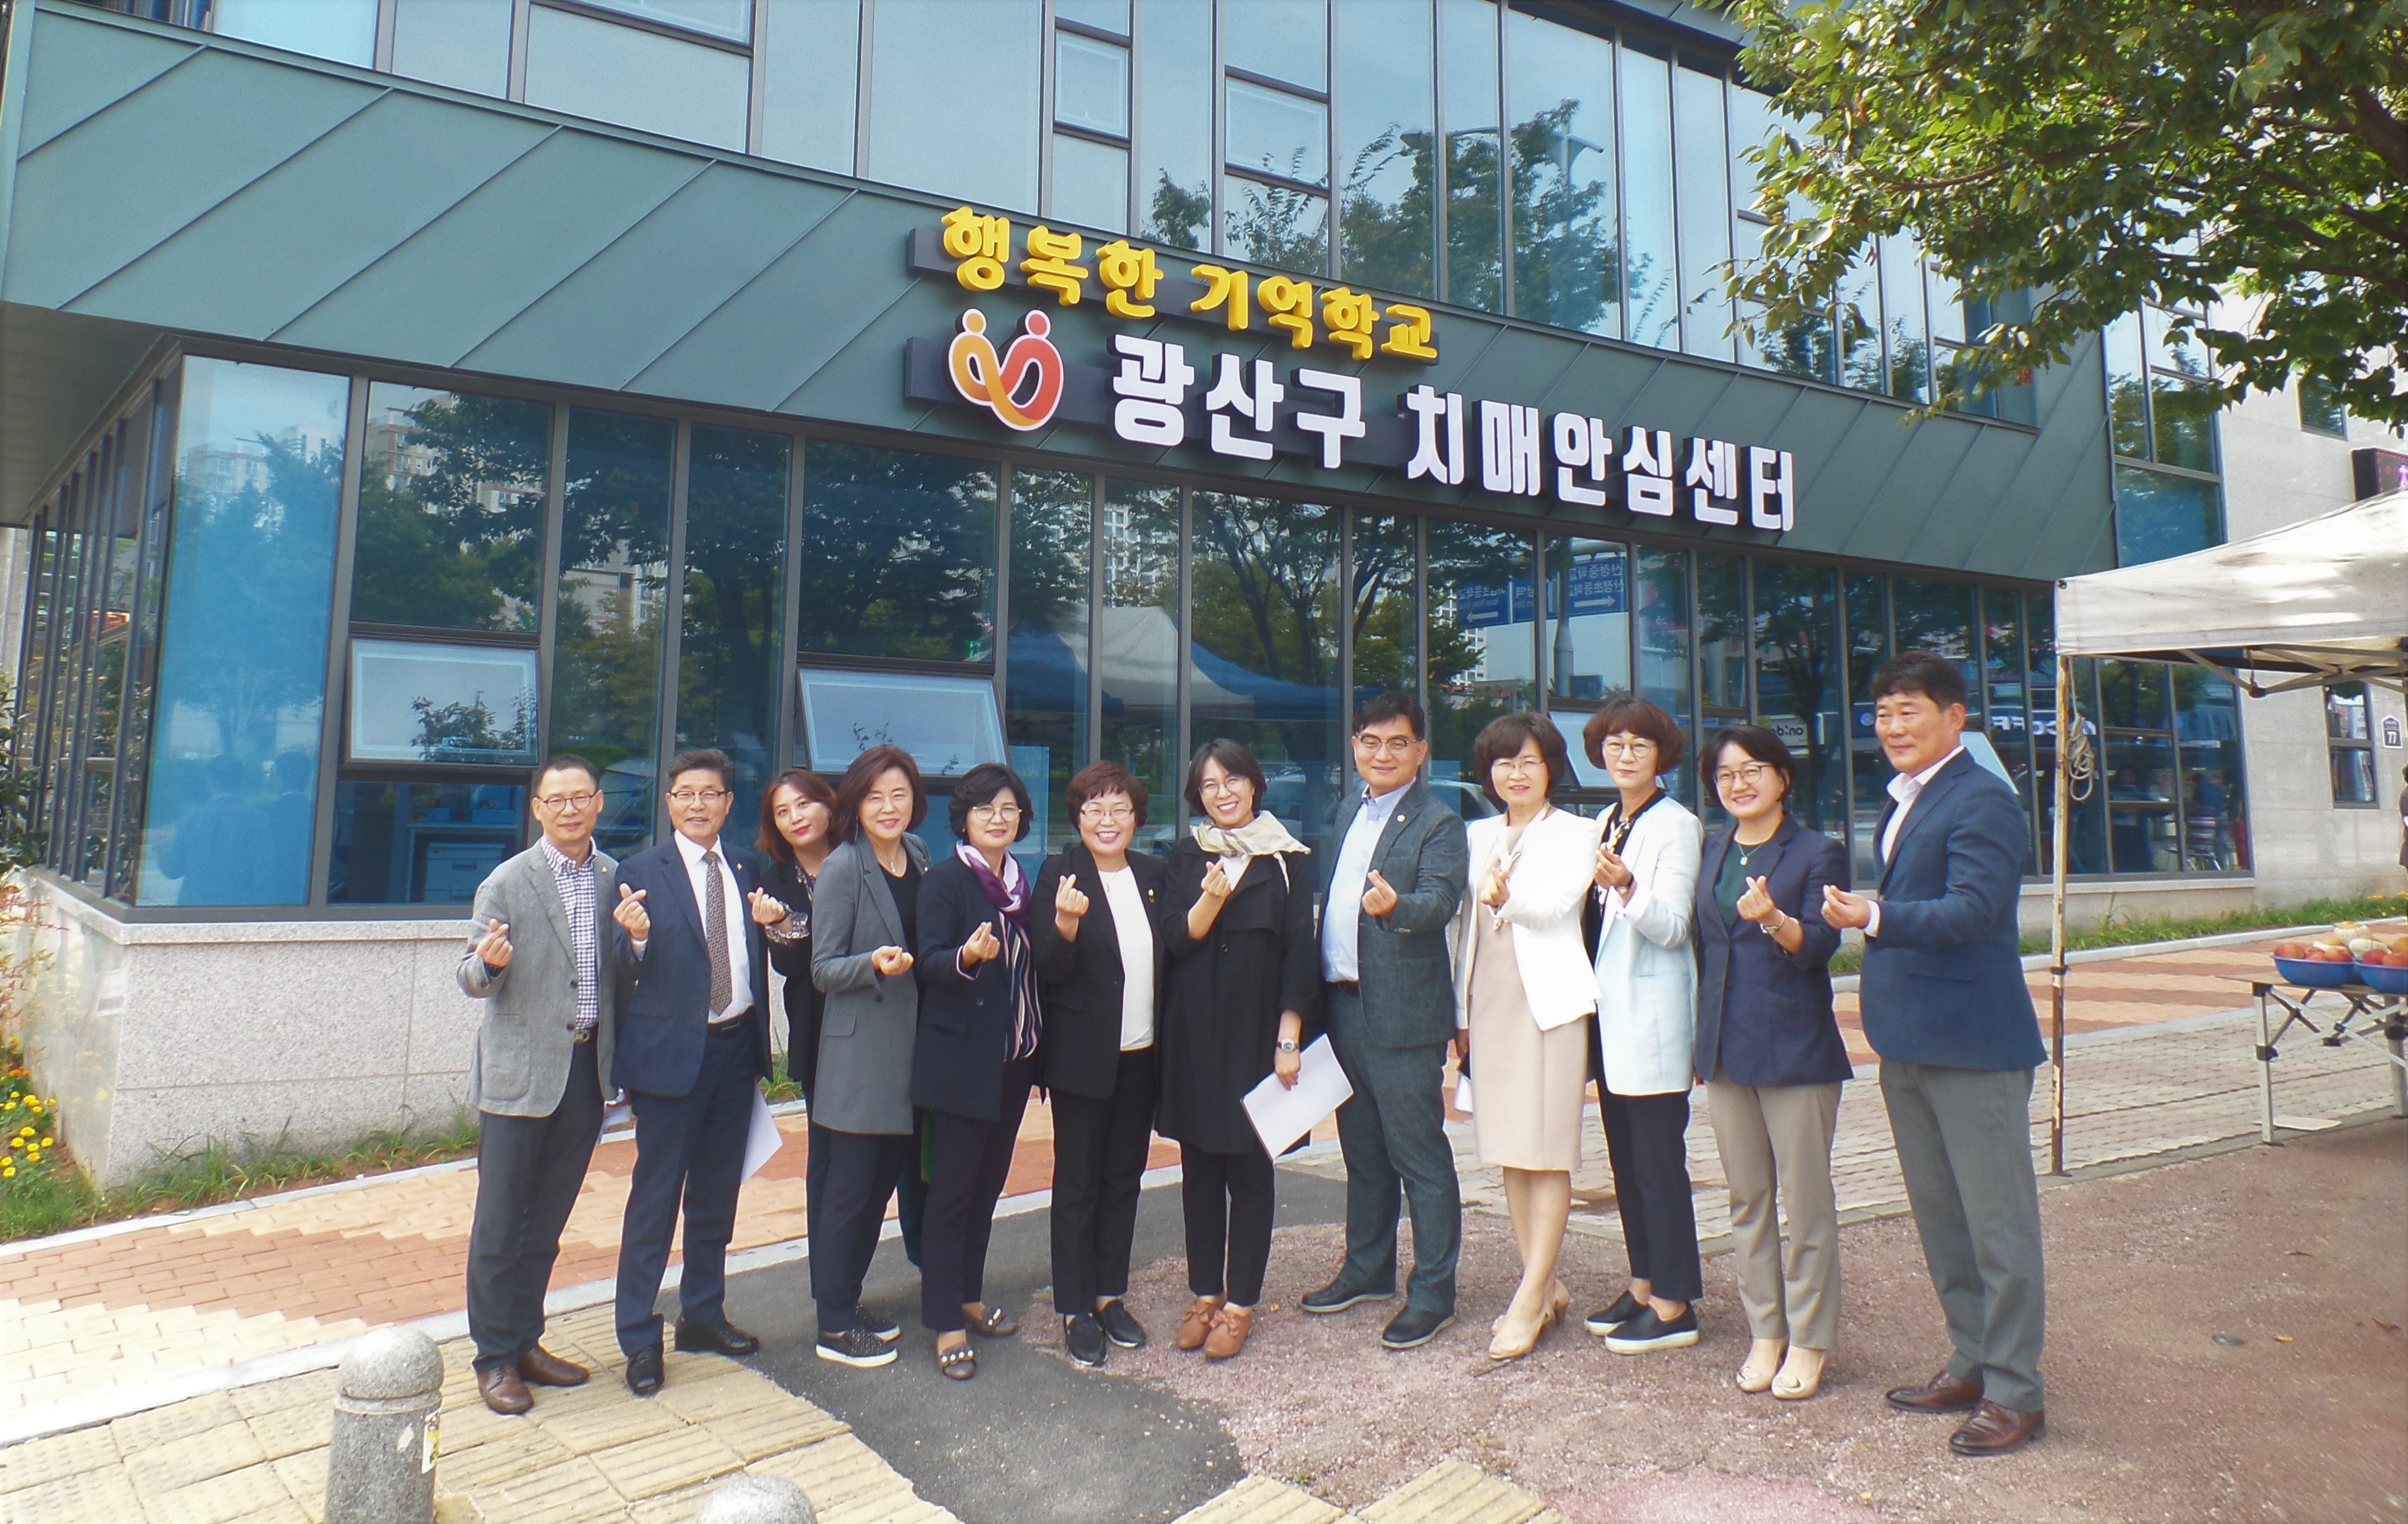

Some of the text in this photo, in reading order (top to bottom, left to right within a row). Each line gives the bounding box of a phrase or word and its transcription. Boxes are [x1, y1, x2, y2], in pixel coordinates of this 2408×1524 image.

[942, 206, 1163, 319] 행복한
[1113, 335, 1795, 531] 광산구 치매안심센터
[2387, 731, 2397, 744] 77
